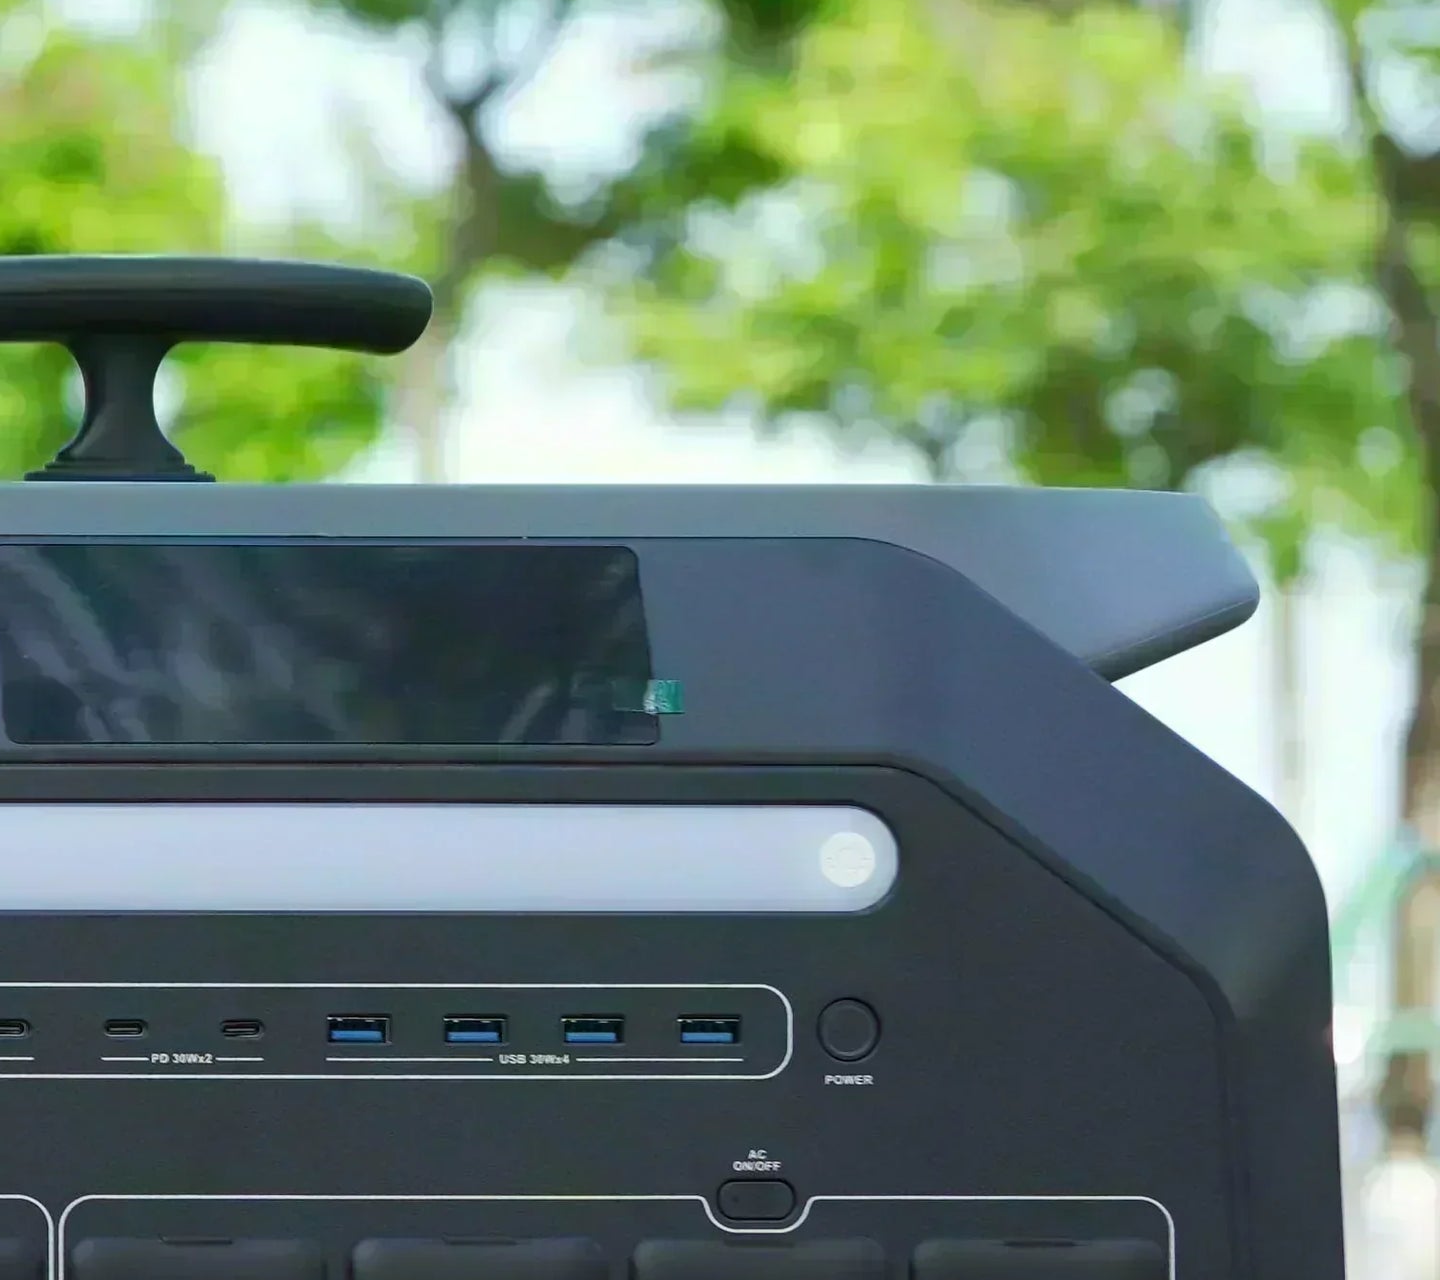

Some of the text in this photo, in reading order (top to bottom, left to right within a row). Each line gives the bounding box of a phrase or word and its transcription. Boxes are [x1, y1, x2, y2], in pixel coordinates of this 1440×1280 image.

[150, 1053, 213, 1064] PD 30Wx2
[498, 1054, 527, 1065] USB
[824, 1074, 874, 1085] POWER
[747, 1149, 768, 1160] AC
[732, 1160, 782, 1172] ON/OFF
